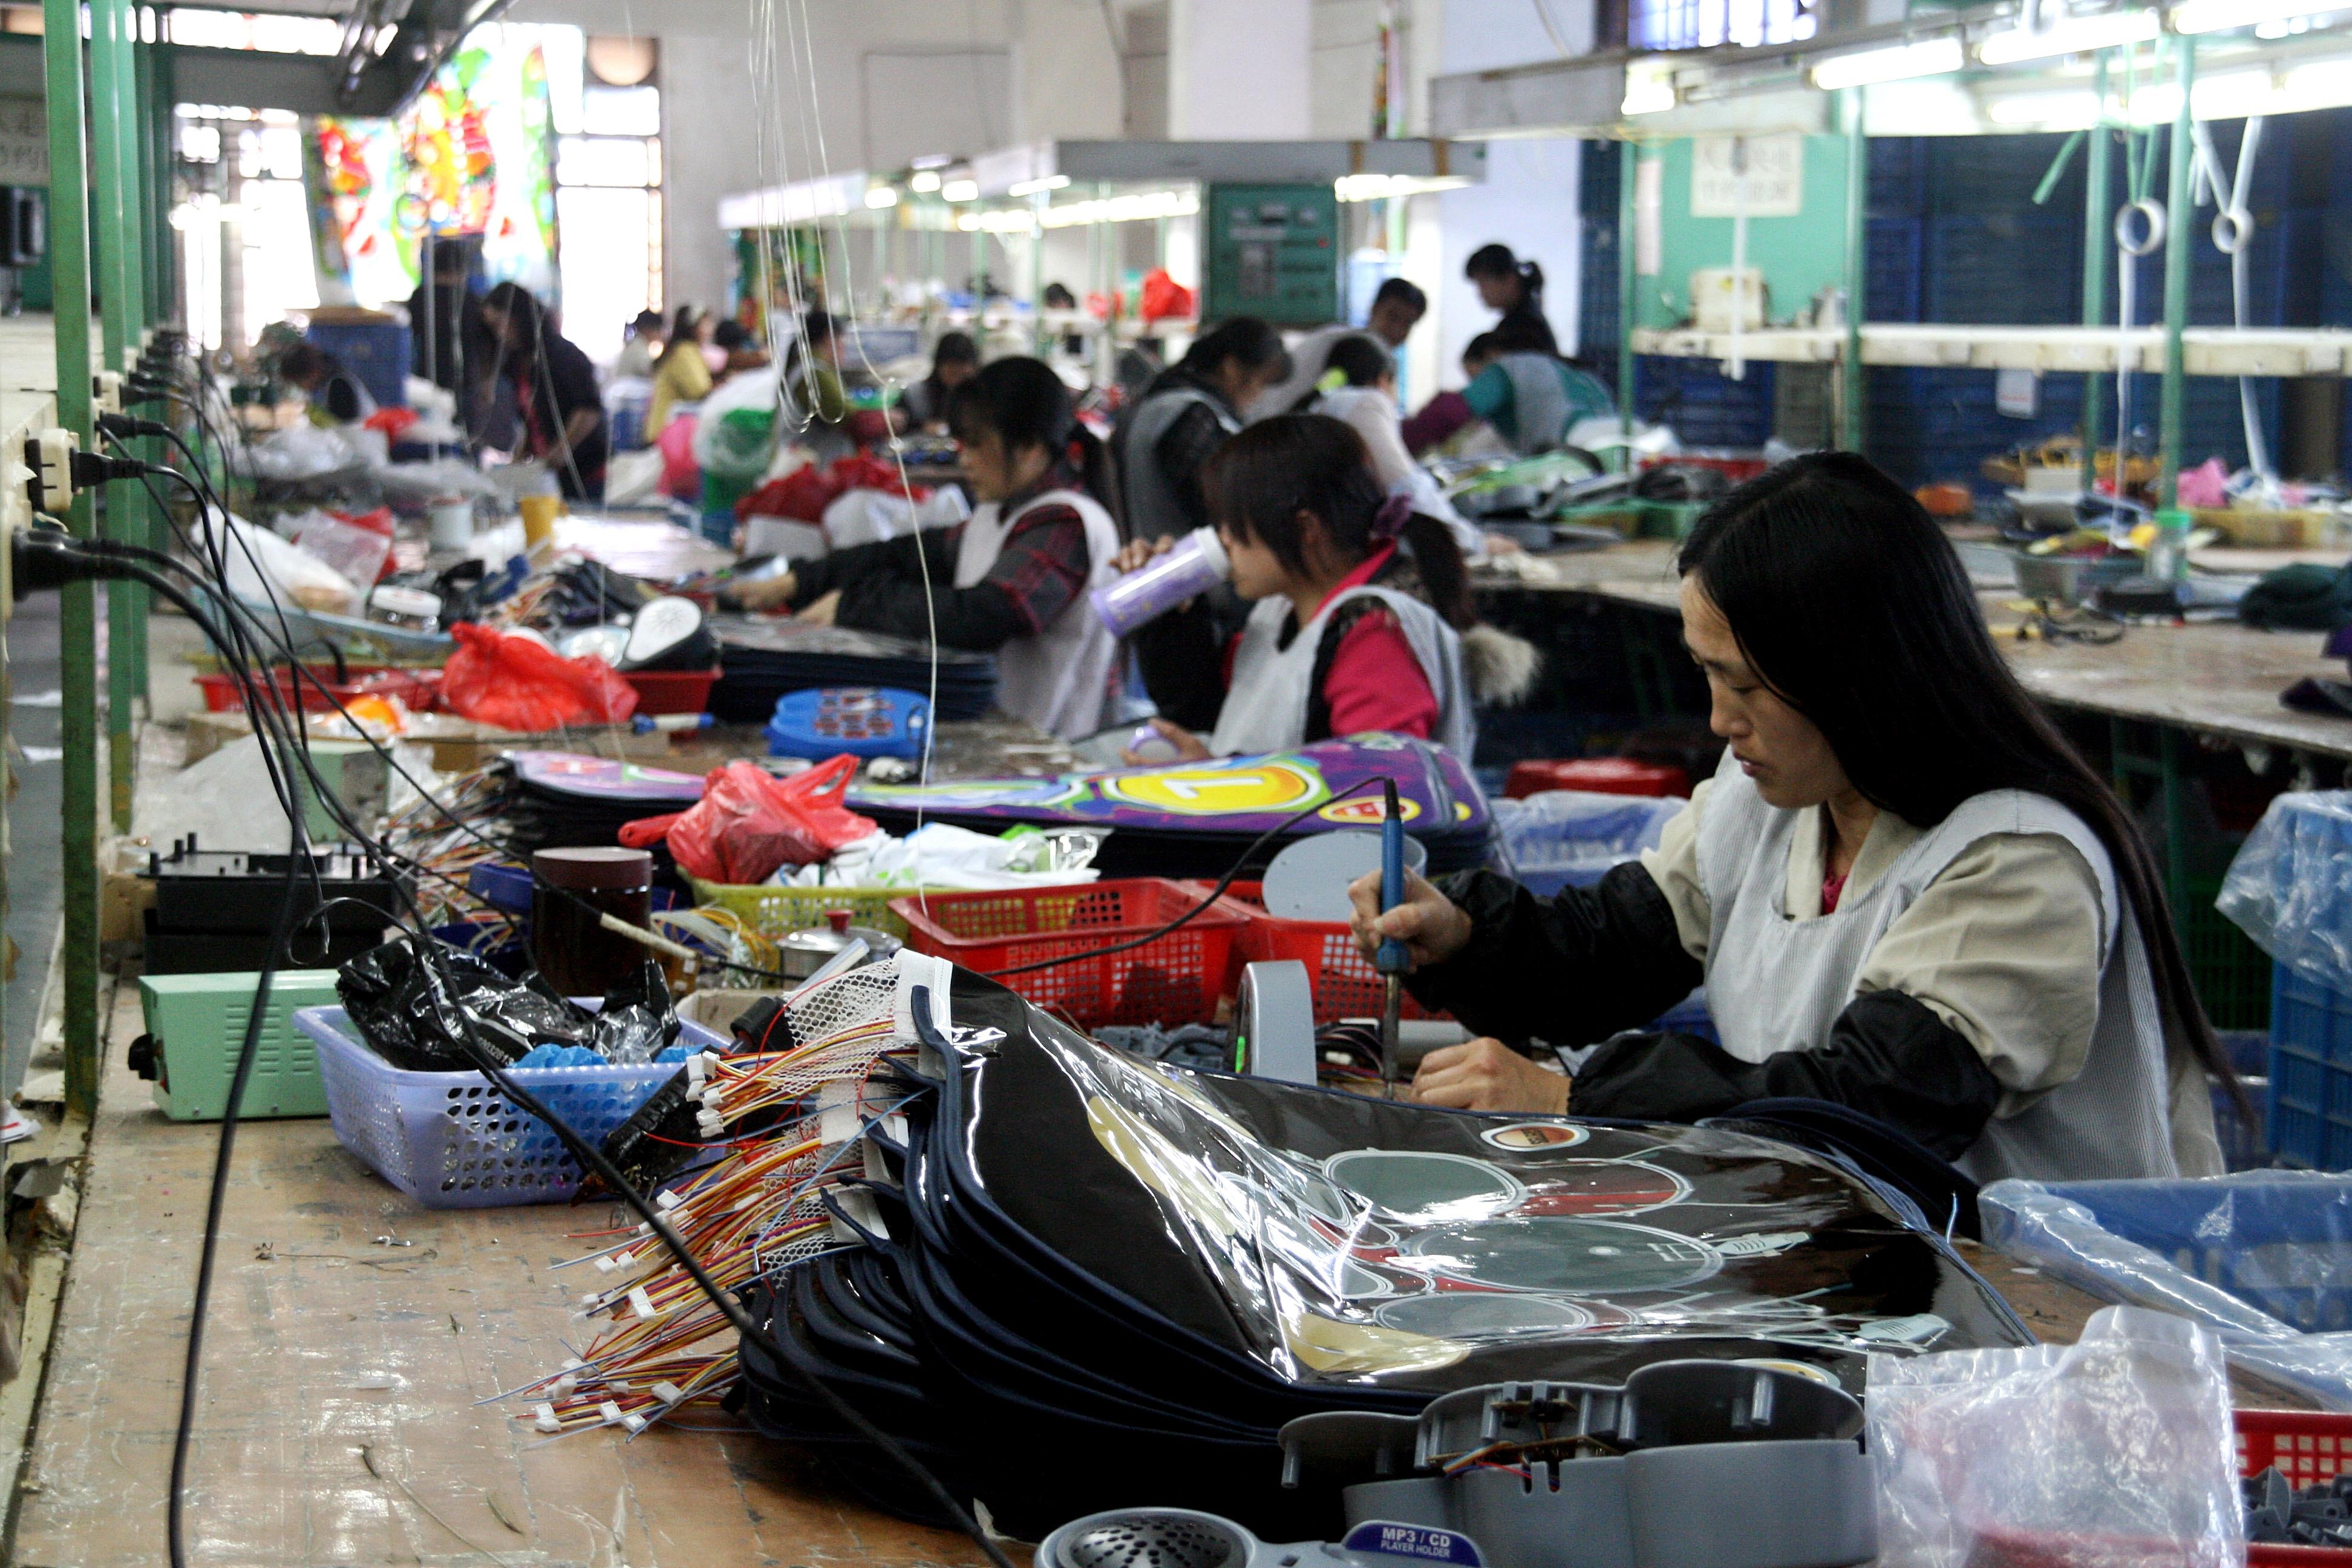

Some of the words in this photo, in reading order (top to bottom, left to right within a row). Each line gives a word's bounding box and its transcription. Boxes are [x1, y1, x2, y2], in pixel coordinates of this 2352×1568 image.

[1382, 1527, 1416, 1543] MP3
[1429, 1533, 1451, 1547] CD
[1380, 1540, 1414, 1553] PLAYER
[1416, 1545, 1451, 1558] HOLDER
